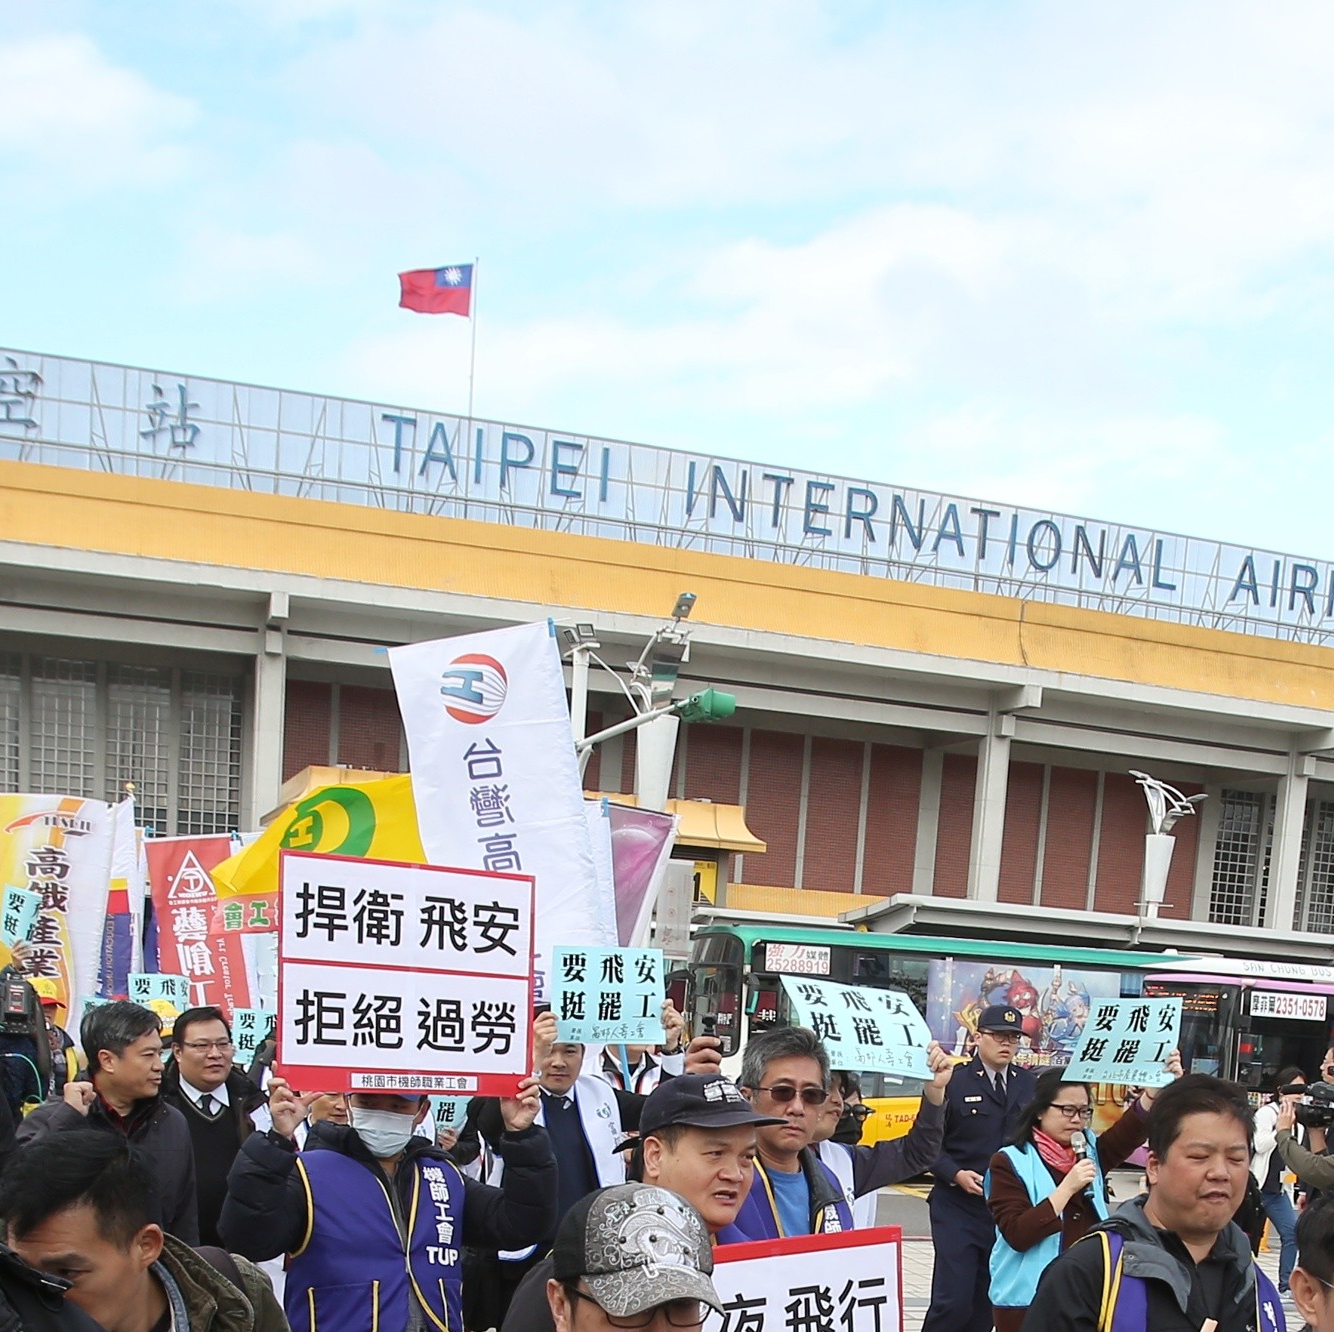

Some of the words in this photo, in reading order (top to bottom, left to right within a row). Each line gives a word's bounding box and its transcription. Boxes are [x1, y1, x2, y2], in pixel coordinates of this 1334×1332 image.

[381, 412, 611, 502] TAIPEI
[685, 460, 1177, 592] INTERNATIONAL
[295, 883, 404, 947] 捍衛
[419, 895, 521, 956] 飛安
[560, 952, 656, 984] 要飛安
[766, 957, 830, 974] 25288919
[560, 990, 657, 1021] 挺罷工
[795, 982, 911, 1018] 要飛安
[295, 989, 404, 1050] 拒絕
[415, 998, 518, 1055] 過勞
[1092, 1003, 1177, 1033] 要飛安
[1079, 1037, 1172, 1064] 挺罷工
[362, 1075, 468, 1090] 桃園市機師職業工會
[422, 1166, 455, 1246] 機師工會
[425, 1246, 459, 1268] TUP
